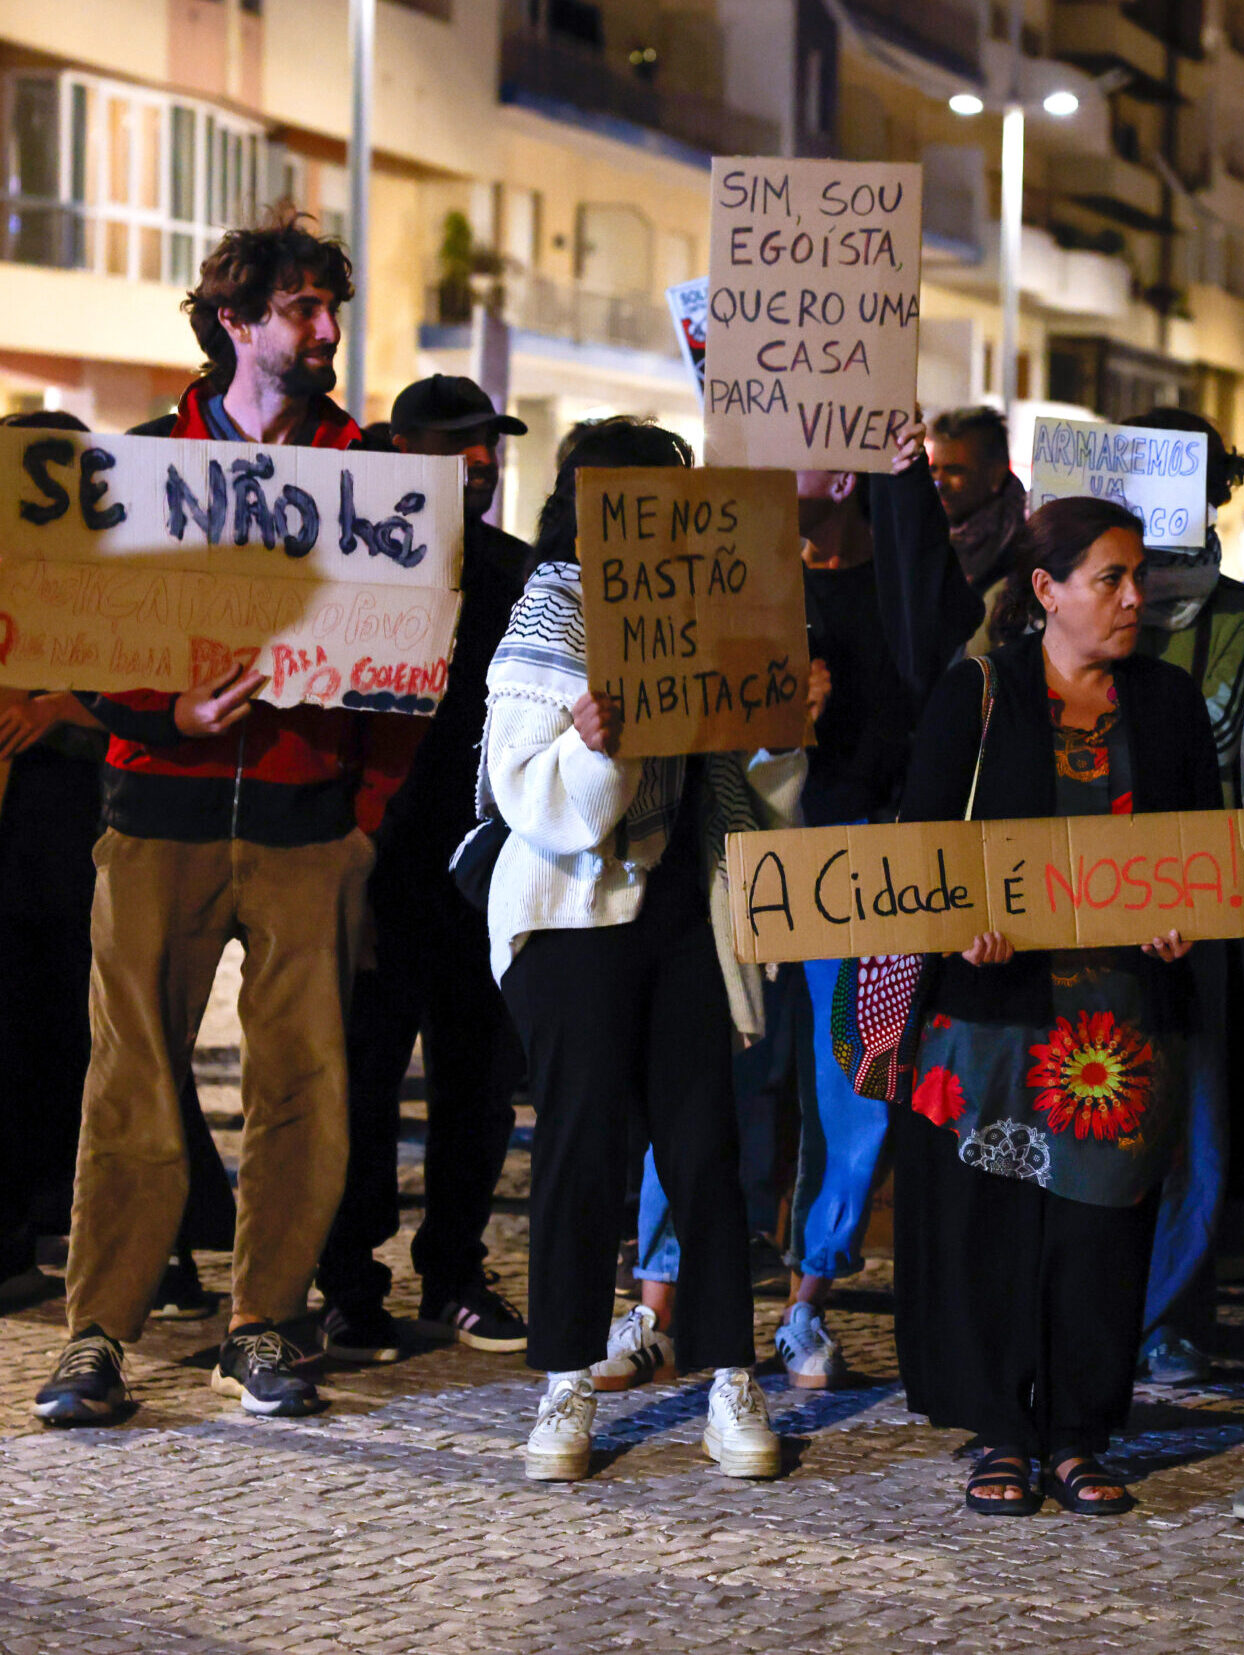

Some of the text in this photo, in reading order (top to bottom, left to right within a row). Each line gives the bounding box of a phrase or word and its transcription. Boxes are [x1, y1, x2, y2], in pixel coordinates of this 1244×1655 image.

[720, 171, 903, 226] SIM, SOU
[731, 226, 903, 271] EGOÍSTA,
[711, 287, 919, 329] QUERO UMA
[757, 340, 870, 375] CASA
[711, 378, 788, 414] PARA
[1034, 422, 1200, 477] A(R)MAREMOS
[20, 438, 127, 530] SE
[167, 453, 320, 557] NÃO
[1090, 476, 1125, 498] UM
[602, 492, 738, 542] MENOS
[603, 542, 747, 602] BASTÃO
[344, 590, 431, 650] POVO
[749, 816, 1244, 936] A Cidade É NOSSA!
